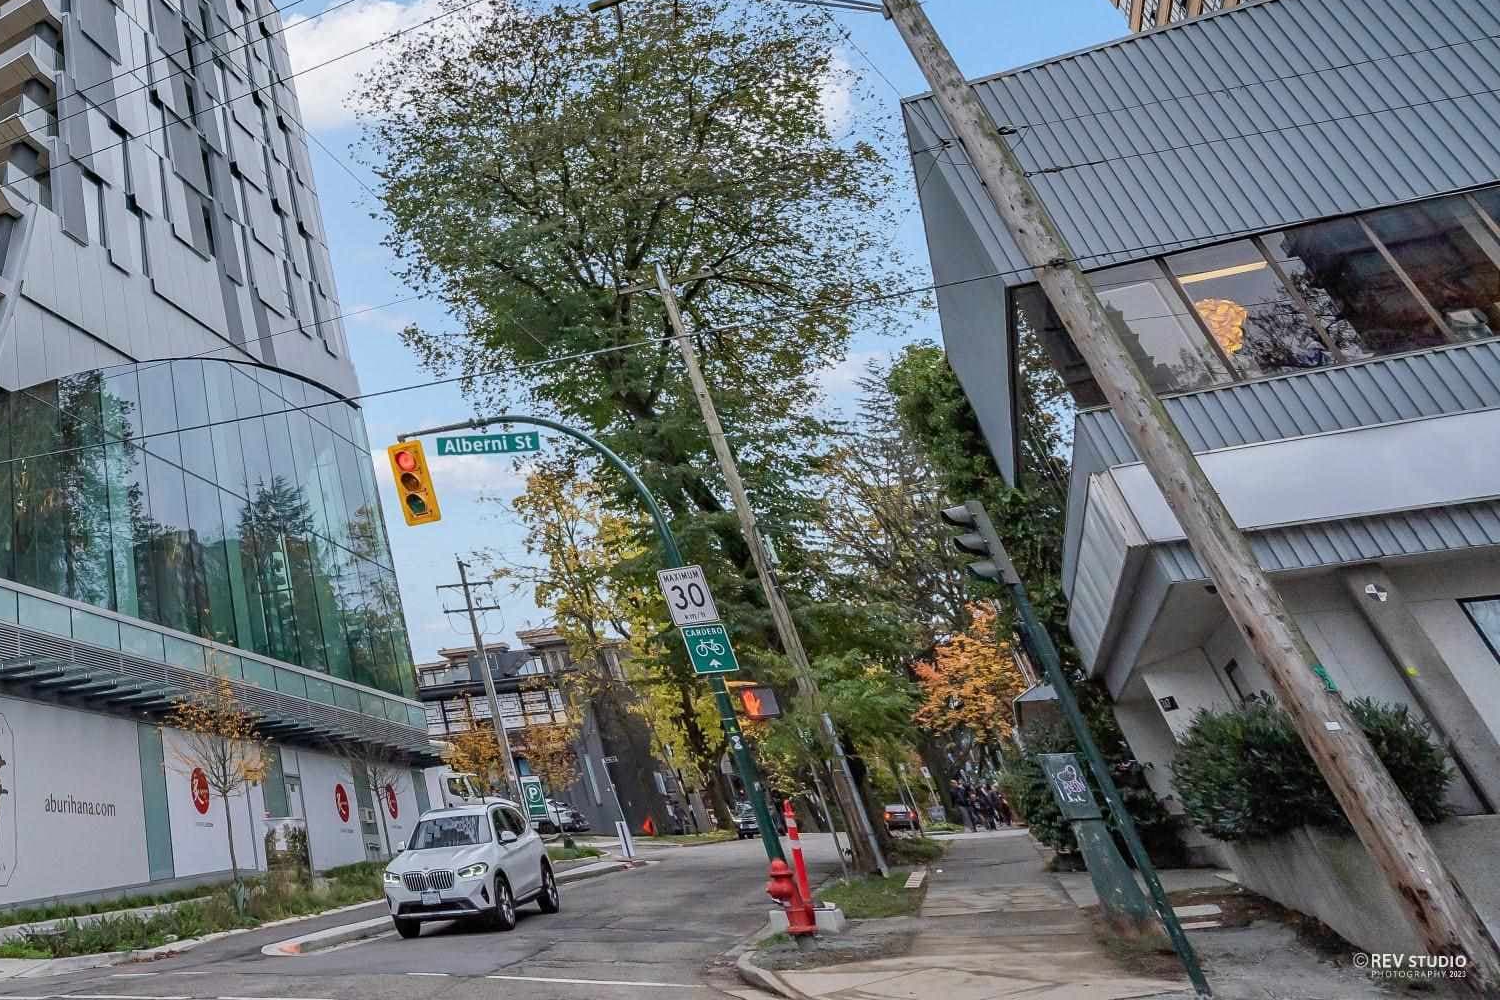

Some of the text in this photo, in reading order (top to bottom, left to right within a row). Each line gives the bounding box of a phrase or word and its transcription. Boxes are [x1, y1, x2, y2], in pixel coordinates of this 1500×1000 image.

[444, 435, 533, 454] Alberni St
[662, 569, 699, 582] MAXIMUM
[670, 582, 706, 610] 30
[685, 627, 723, 637] CARDERO
[44, 792, 116, 817] aburihana.com
